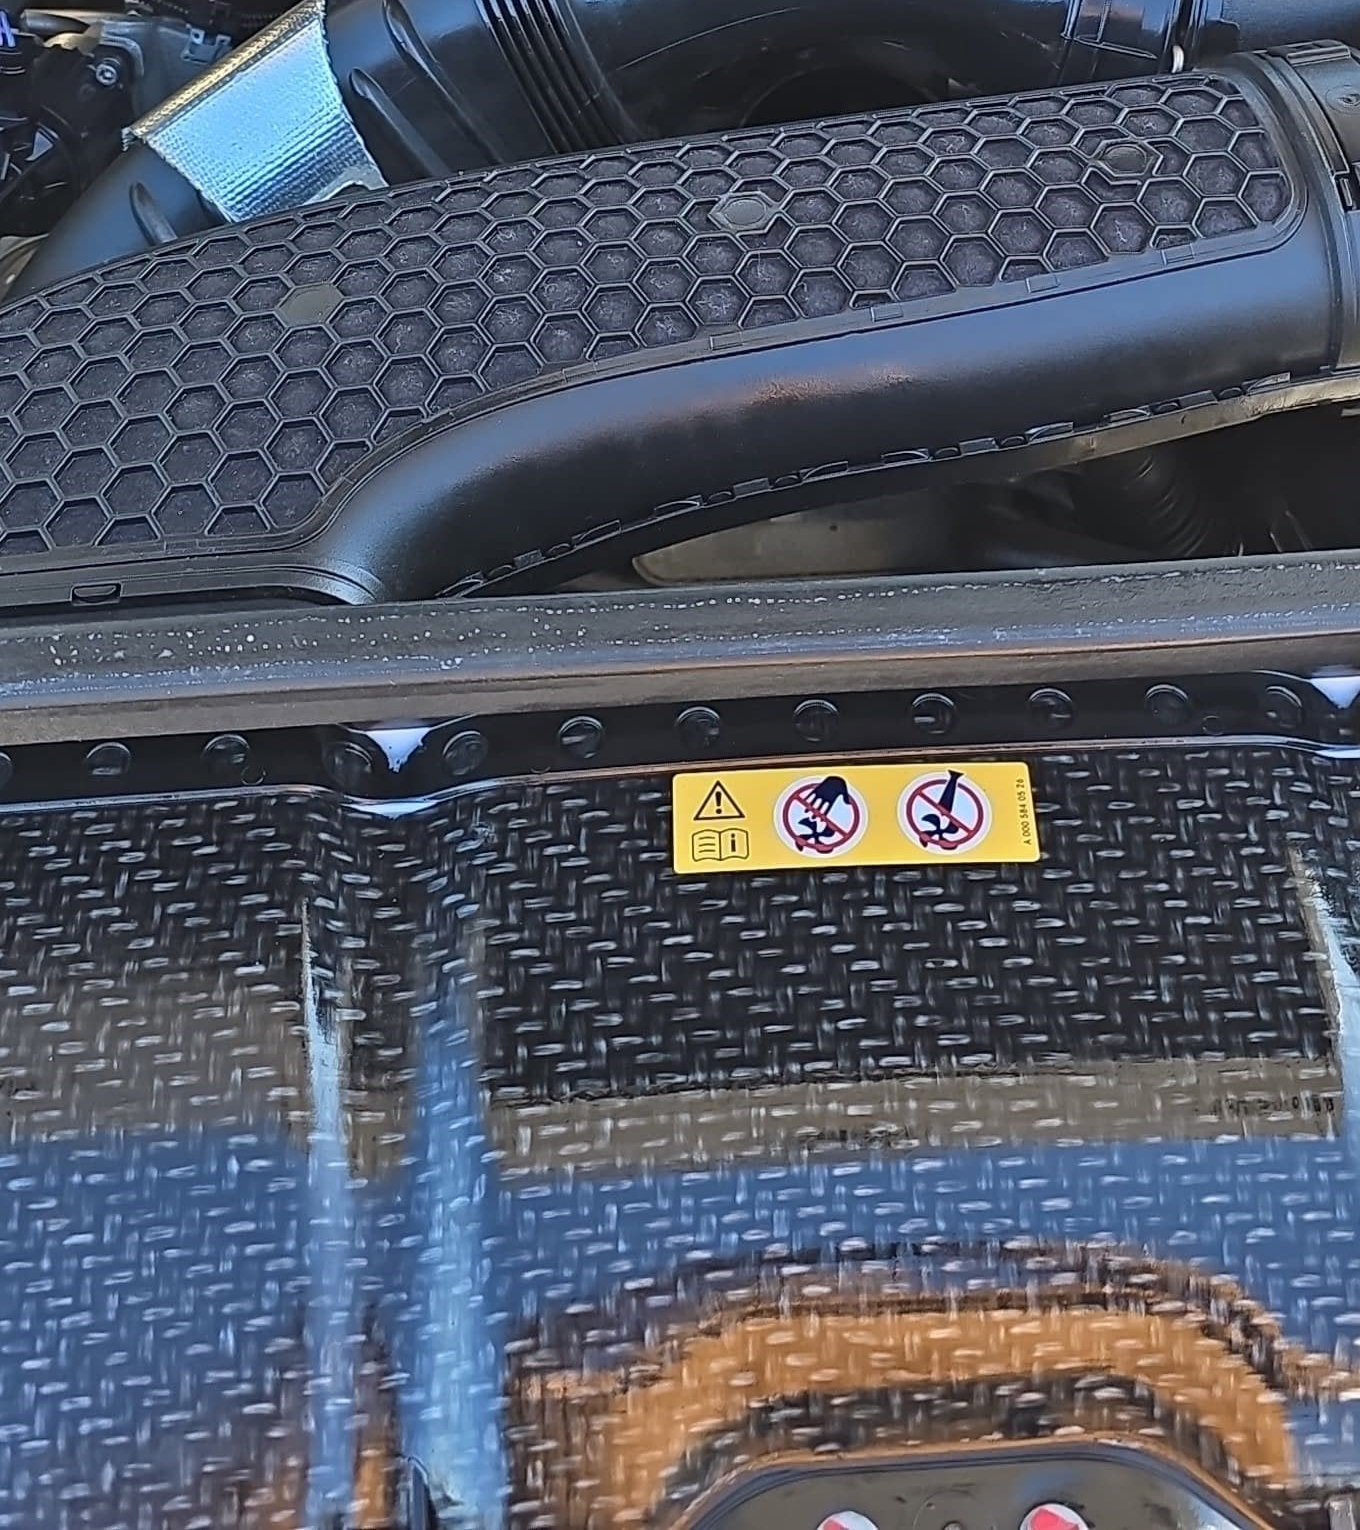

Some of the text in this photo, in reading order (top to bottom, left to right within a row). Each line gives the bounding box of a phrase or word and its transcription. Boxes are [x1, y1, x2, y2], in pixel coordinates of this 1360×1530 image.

[1015, 778, 1025, 789] 26
[1016, 791, 1027, 802] 05
[1019, 803, 1029, 819] 584
[1020, 820, 1031, 838] 000
